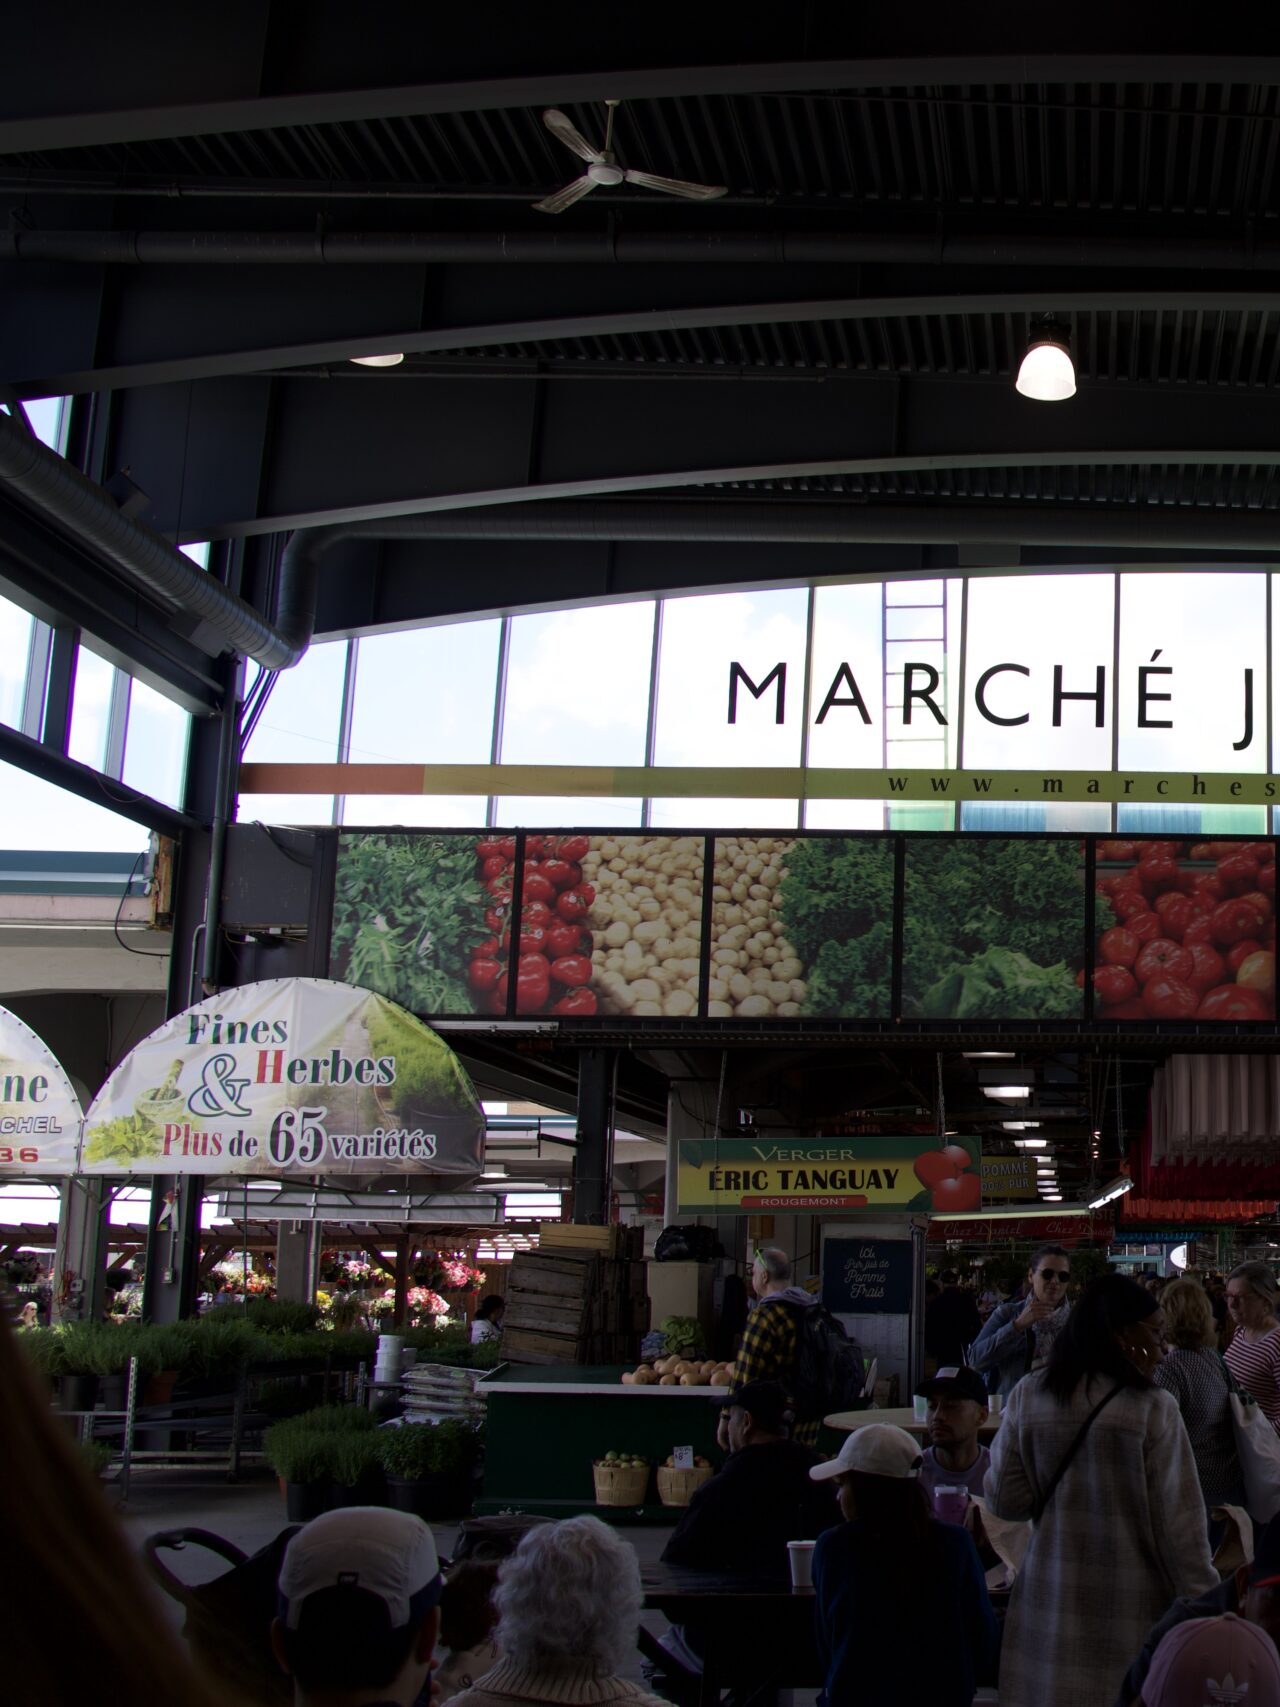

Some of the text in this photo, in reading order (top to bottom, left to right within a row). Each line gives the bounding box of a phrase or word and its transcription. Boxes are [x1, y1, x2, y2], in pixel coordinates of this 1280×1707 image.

[727, 649, 1173, 729] MARCHÉ
[185, 1014, 288, 1045] Fines
[254, 1049, 394, 1084] Herbes
[161, 1110, 435, 1163] Plus de 65 variétés
[709, 1166, 899, 1191] ÉRIC TANGUAY
[982, 1162, 1029, 1177] POMME
[1009, 1178, 1029, 1189] PUR
[760, 1197, 848, 1206] ROUGEMONT
[844, 1269, 886, 1283] Pomme
[850, 1283, 885, 1299] Frais
